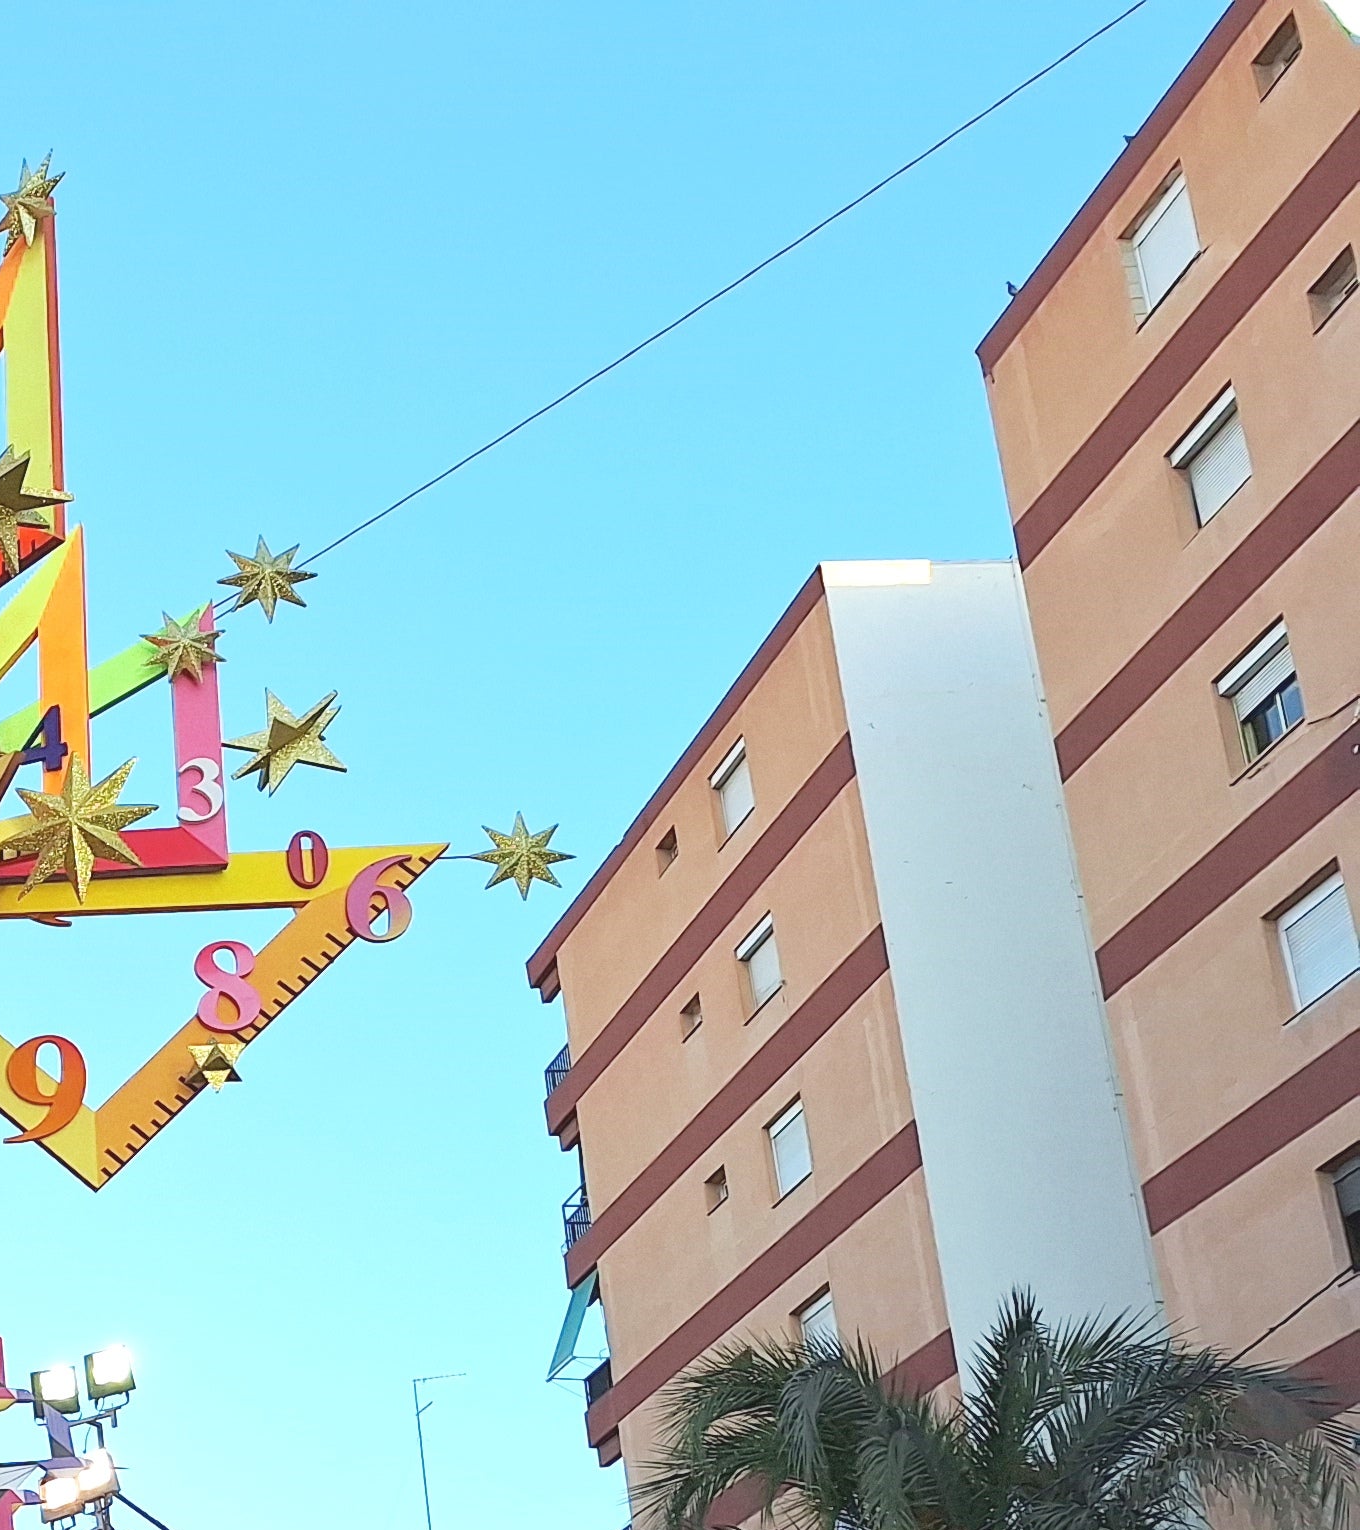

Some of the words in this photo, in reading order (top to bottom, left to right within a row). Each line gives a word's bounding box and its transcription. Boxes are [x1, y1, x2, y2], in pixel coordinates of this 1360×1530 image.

[176, 757, 224, 823] 3
[344, 854, 412, 942] 6
[193, 940, 260, 1033] 8
[4, 1035, 86, 1144] 9
